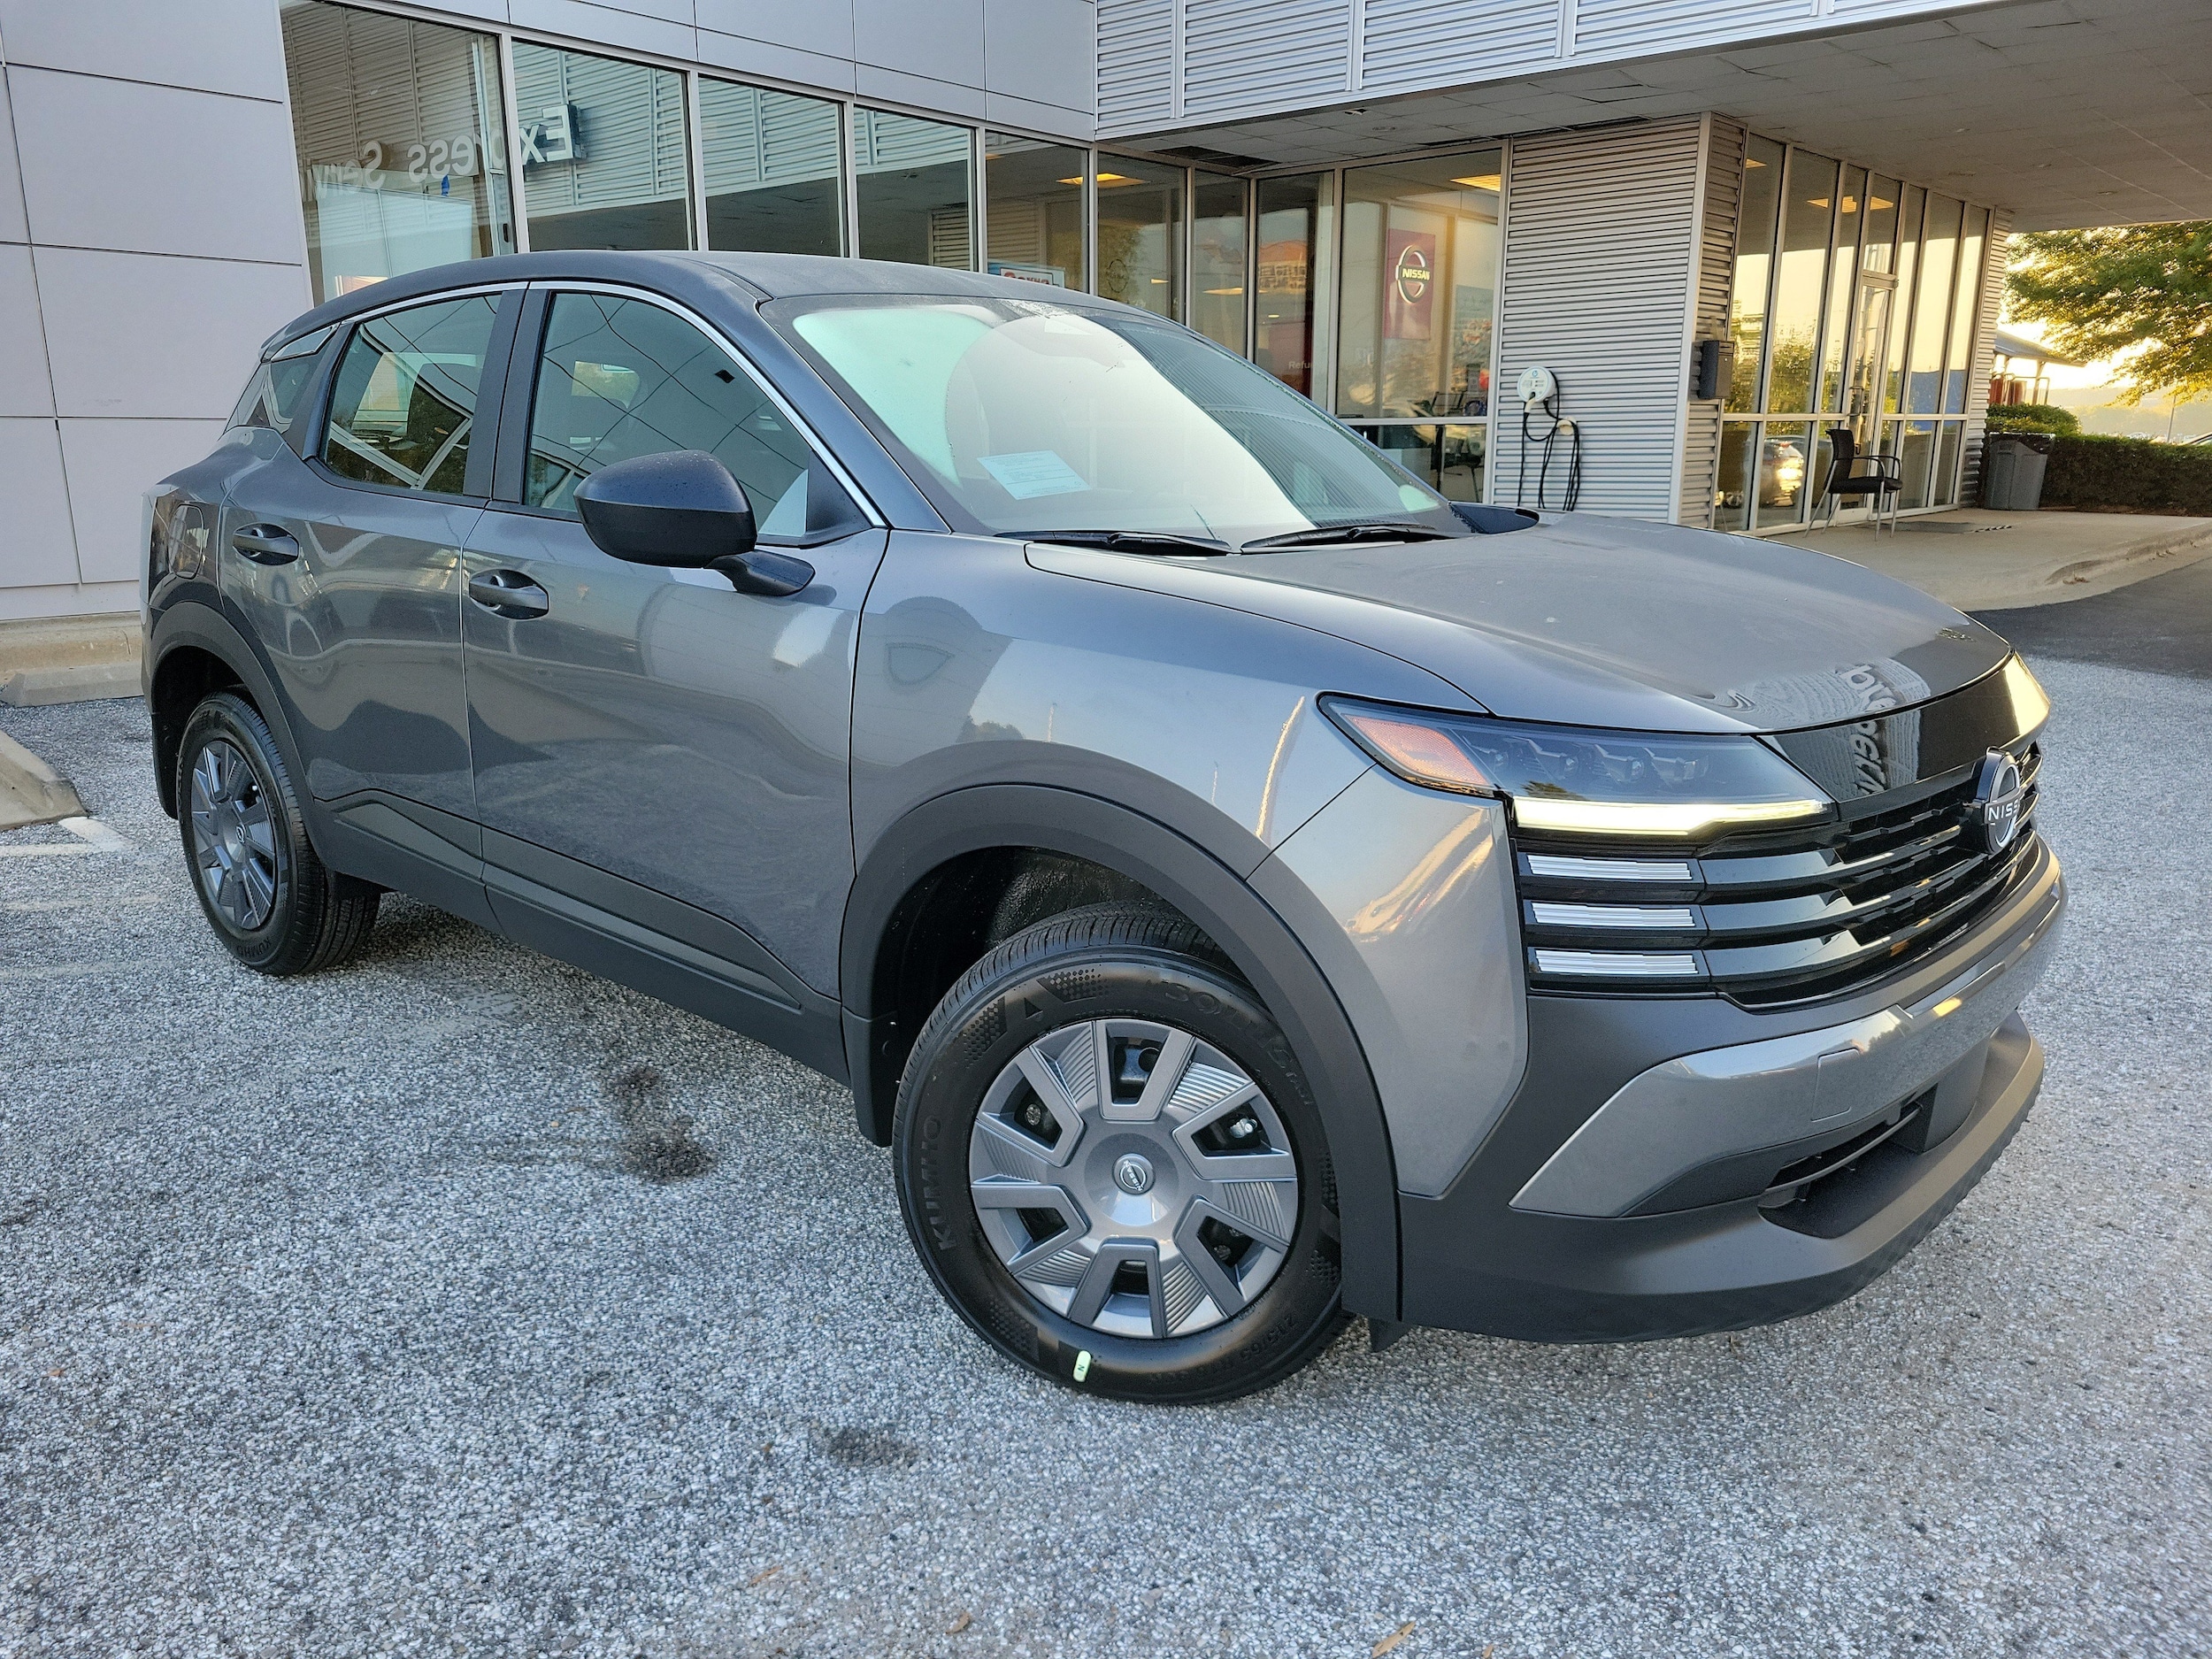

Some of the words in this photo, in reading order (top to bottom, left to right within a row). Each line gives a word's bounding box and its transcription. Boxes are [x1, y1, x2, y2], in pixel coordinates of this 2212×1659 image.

[1402, 267, 1431, 281] NISSAN
[1987, 798, 2021, 821] NISS
[920, 1114, 957, 1251] KUMHO
[1124, 1160, 1144, 1191] NISSAN
